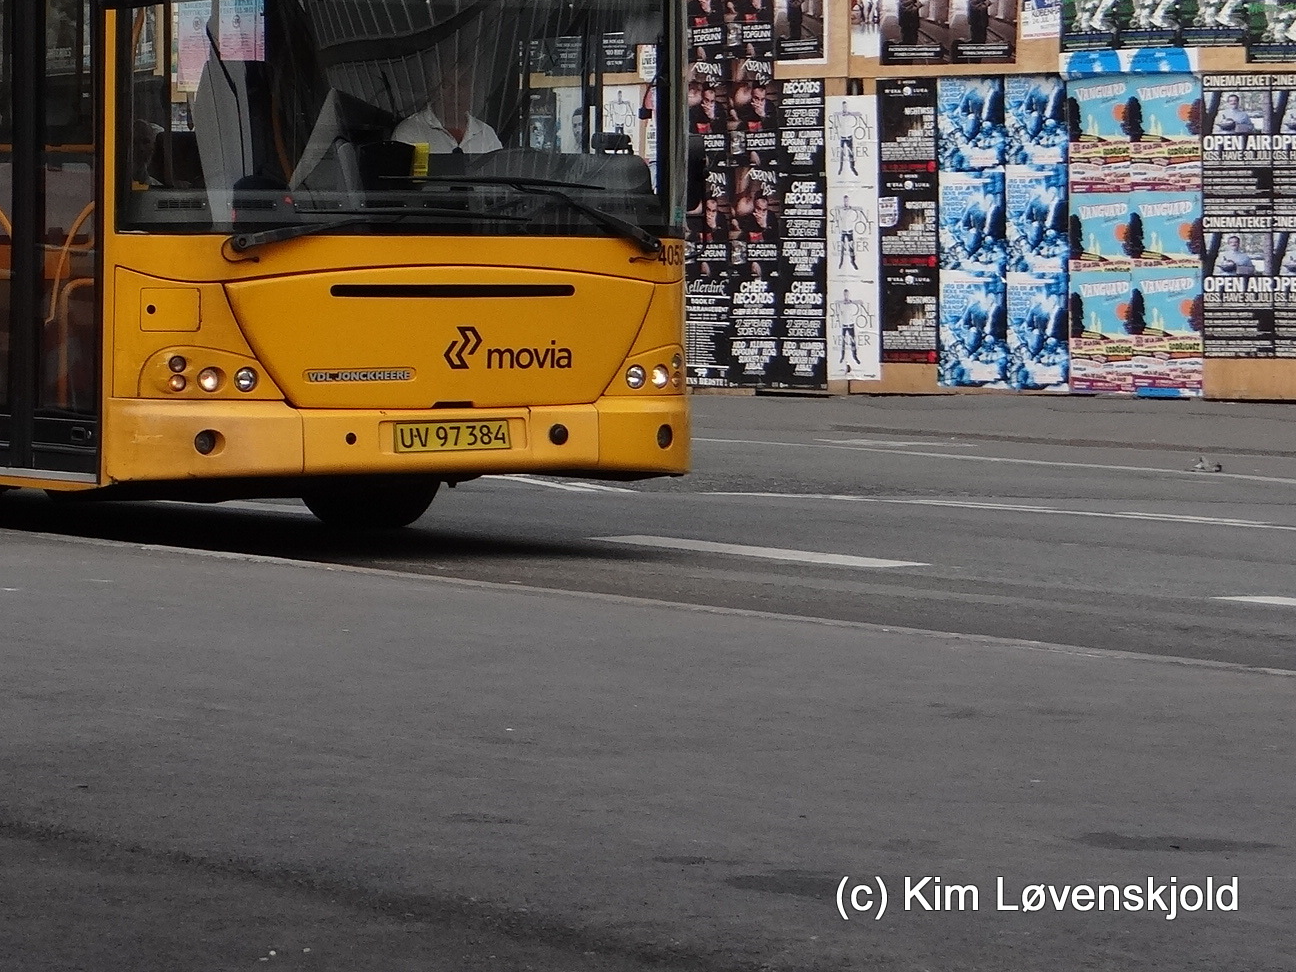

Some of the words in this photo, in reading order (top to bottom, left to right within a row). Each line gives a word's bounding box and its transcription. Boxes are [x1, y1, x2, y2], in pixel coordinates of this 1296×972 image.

[1204, 75, 1271, 86] CINEMATEKET
[1272, 75, 1296, 86] CINE
[783, 82, 820, 94] RECORDS
[1076, 83, 1125, 101] VANGUARD
[1138, 82, 1192, 100] VANGUARD
[604, 114, 636, 128] TAOT
[829, 126, 873, 140] TAOT
[704, 139, 724, 147] PGUNN
[1204, 135, 1243, 151] OPEN
[1246, 135, 1271, 150] AIR
[1203, 151, 1221, 161] KGS.
[1223, 151, 1243, 161] HAVE
[1256, 150, 1271, 160] JULI
[784, 193, 823, 204] RECORDS
[1078, 201, 1127, 219] VANGUARD
[1138, 199, 1193, 218] VANGUARD
[830, 221, 874, 235] TAOT
[1203, 217, 1272, 228] CINEMATEKET
[1080, 281, 1129, 297] VANGUARD
[1141, 277, 1194, 294] VANGUARD
[1204, 276, 1244, 292] OPEN
[1247, 276, 1272, 292] AIR
[733, 293, 774, 304] RECORDS
[784, 293, 822, 305] RECORDS
[1204, 293, 1221, 303] KGS.
[1223, 293, 1243, 302] HAVE
[1256, 292, 1272, 302] JULI
[830, 315, 875, 328] TAOT
[487, 340, 573, 370] movia
[309, 371, 333, 381] VDL
[335, 370, 411, 381] JONCKHEERE
[400, 427, 429, 448] UV
